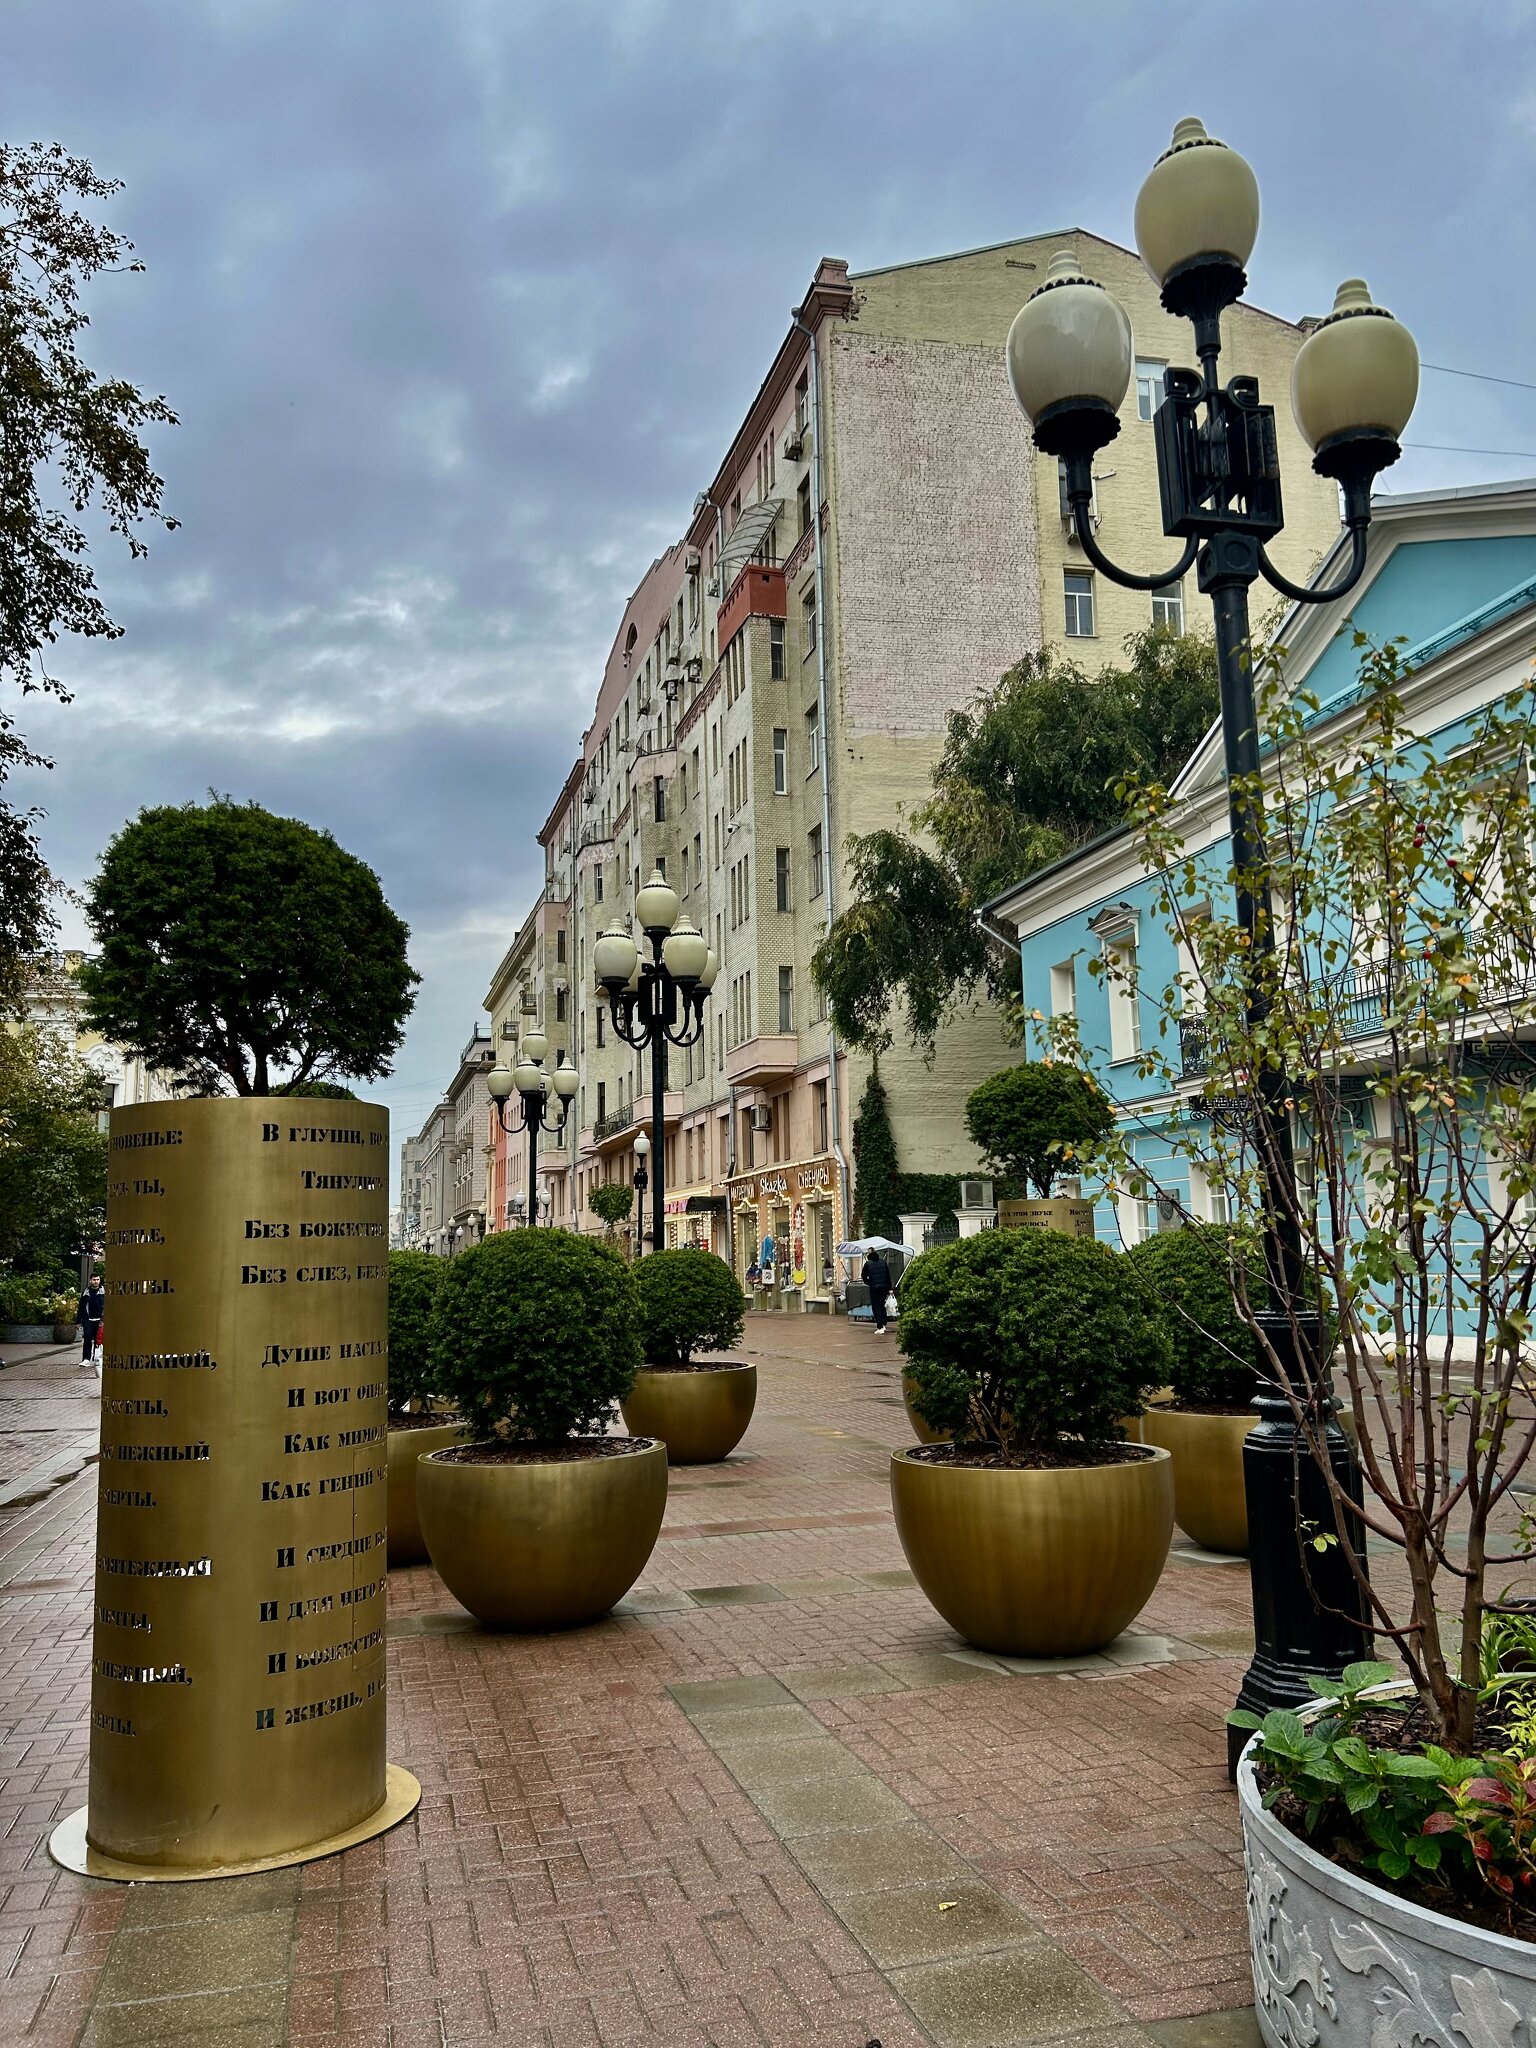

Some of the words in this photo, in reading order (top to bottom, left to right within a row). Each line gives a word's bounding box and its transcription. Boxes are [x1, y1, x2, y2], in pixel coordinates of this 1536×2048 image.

[262, 1123, 279, 1142] В
[760, 1174, 788, 1197] Skazka
[797, 1166, 830, 1189] СУВЕНИРЫ
[287, 1388, 305, 1408] И
[276, 1546, 296, 1569] И
[259, 1600, 279, 1623] И
[267, 1651, 287, 1675] И
[255, 1708, 275, 1731] И
